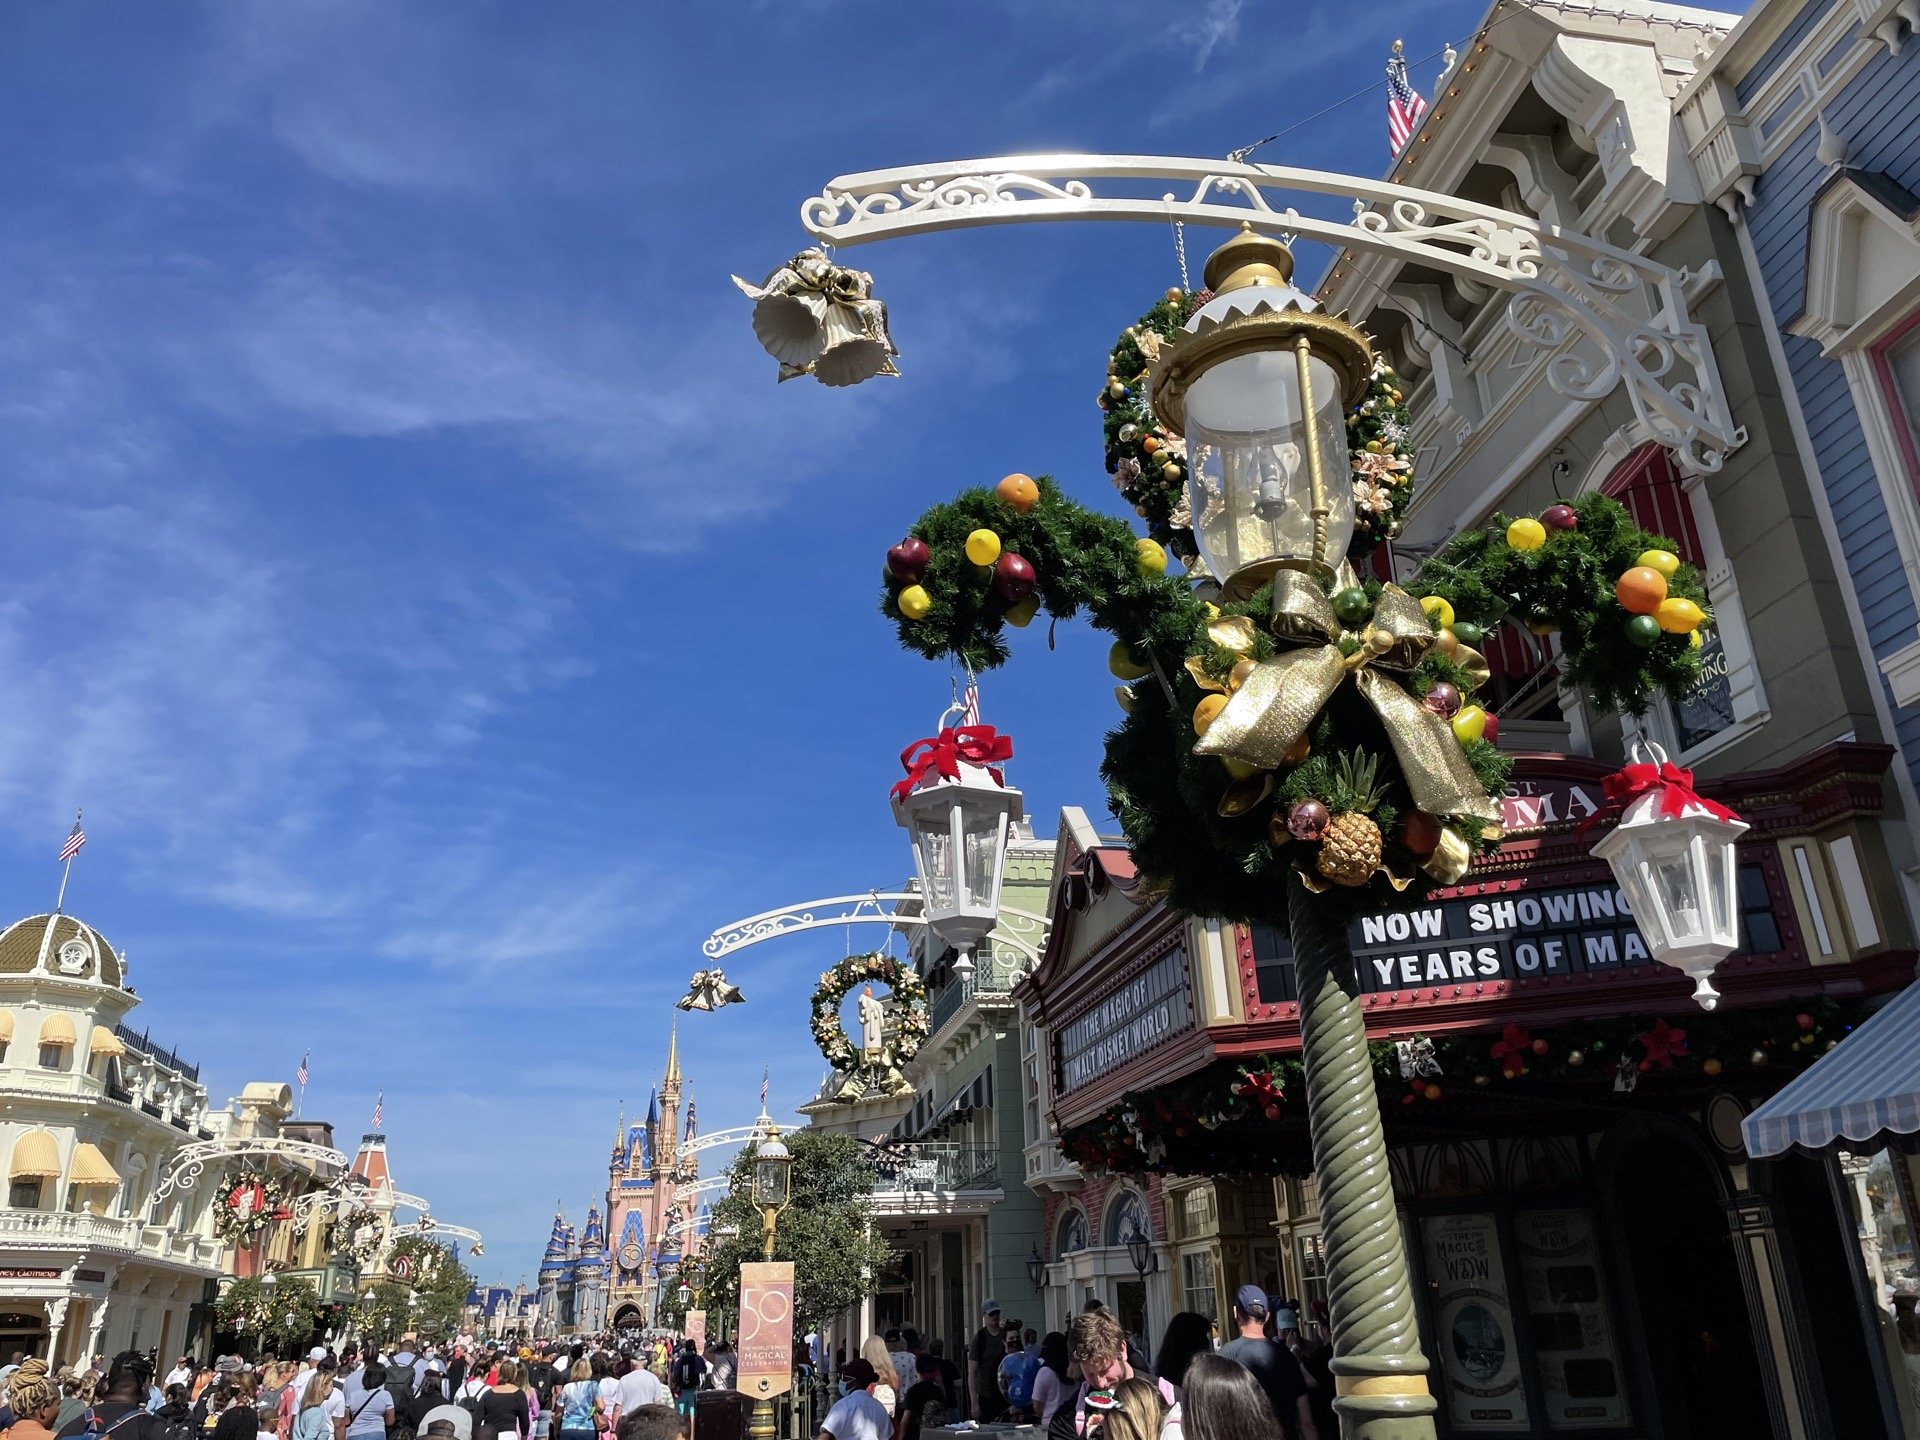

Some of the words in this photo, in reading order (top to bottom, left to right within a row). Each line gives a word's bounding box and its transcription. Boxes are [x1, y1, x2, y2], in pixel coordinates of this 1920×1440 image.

[1361, 908, 1442, 944] NOW
[1372, 948, 1500, 985] YEARS
[1515, 941, 1562, 971] OF
[1584, 933, 1648, 964] MA
[1084, 1013, 1100, 1040] THE
[1103, 991, 1131, 1029] MAGIC
[1133, 980, 1146, 1007] OF
[1074, 1050, 1095, 1081] WALT
[1098, 1030, 1130, 1067] DISNEY
[1132, 1006, 1169, 1047] WORLD
[624, 1248, 640, 1266] 50
[744, 1288, 789, 1341] 50
[744, 1351, 786, 1360] MAGICAL
